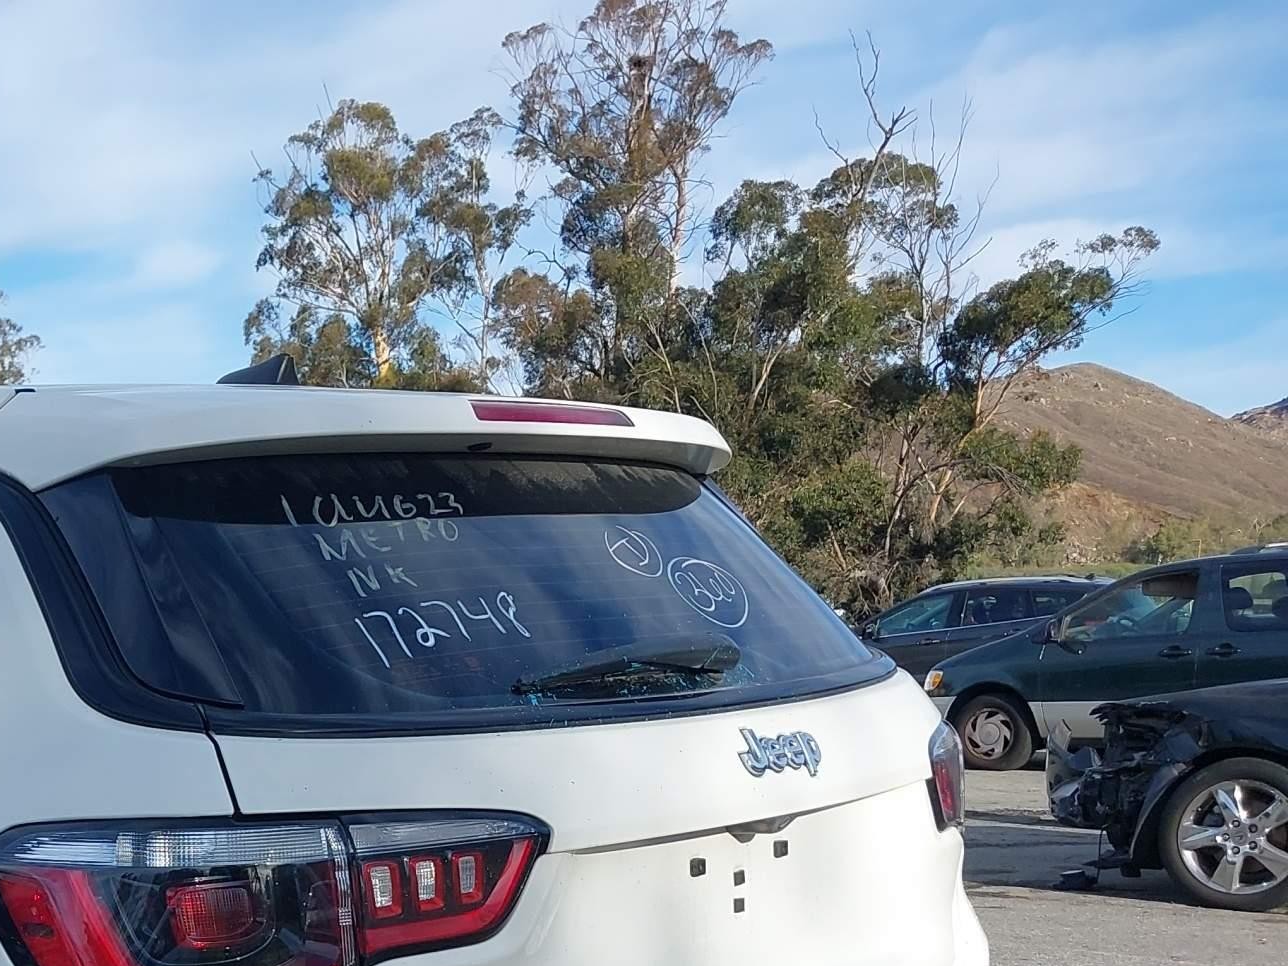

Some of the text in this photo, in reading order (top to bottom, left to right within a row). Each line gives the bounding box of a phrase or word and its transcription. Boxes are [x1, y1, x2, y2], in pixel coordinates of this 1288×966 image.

[313, 516, 459, 561] METRO
[354, 591, 532, 669] 172748
[737, 728, 822, 777] Jeep
